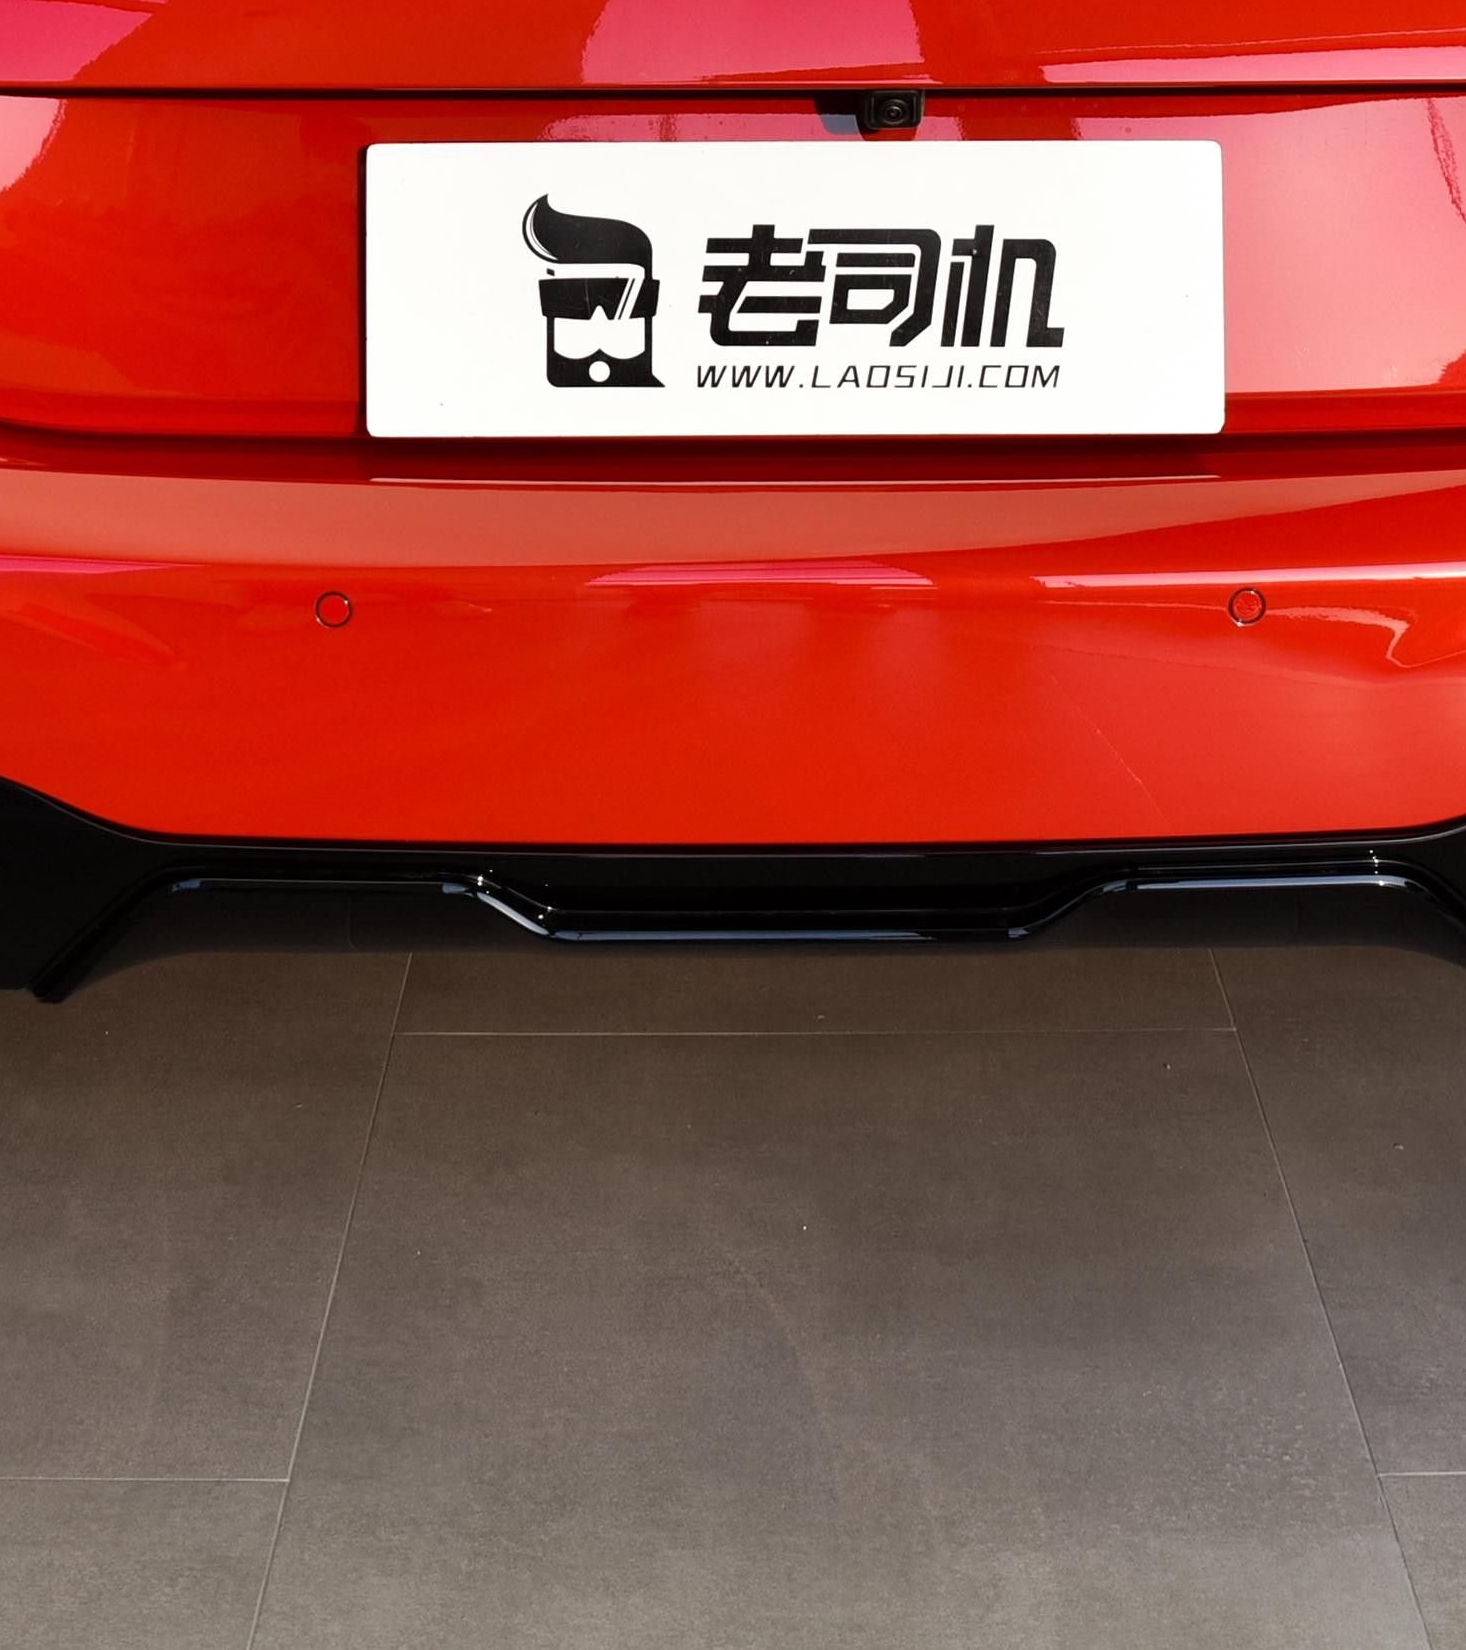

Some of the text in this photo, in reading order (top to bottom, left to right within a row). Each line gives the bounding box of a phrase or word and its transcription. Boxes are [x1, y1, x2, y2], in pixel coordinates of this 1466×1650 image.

[697, 223, 1065, 348] 老司机
[696, 363, 1061, 389] WWW.LAOSIJI.COM
